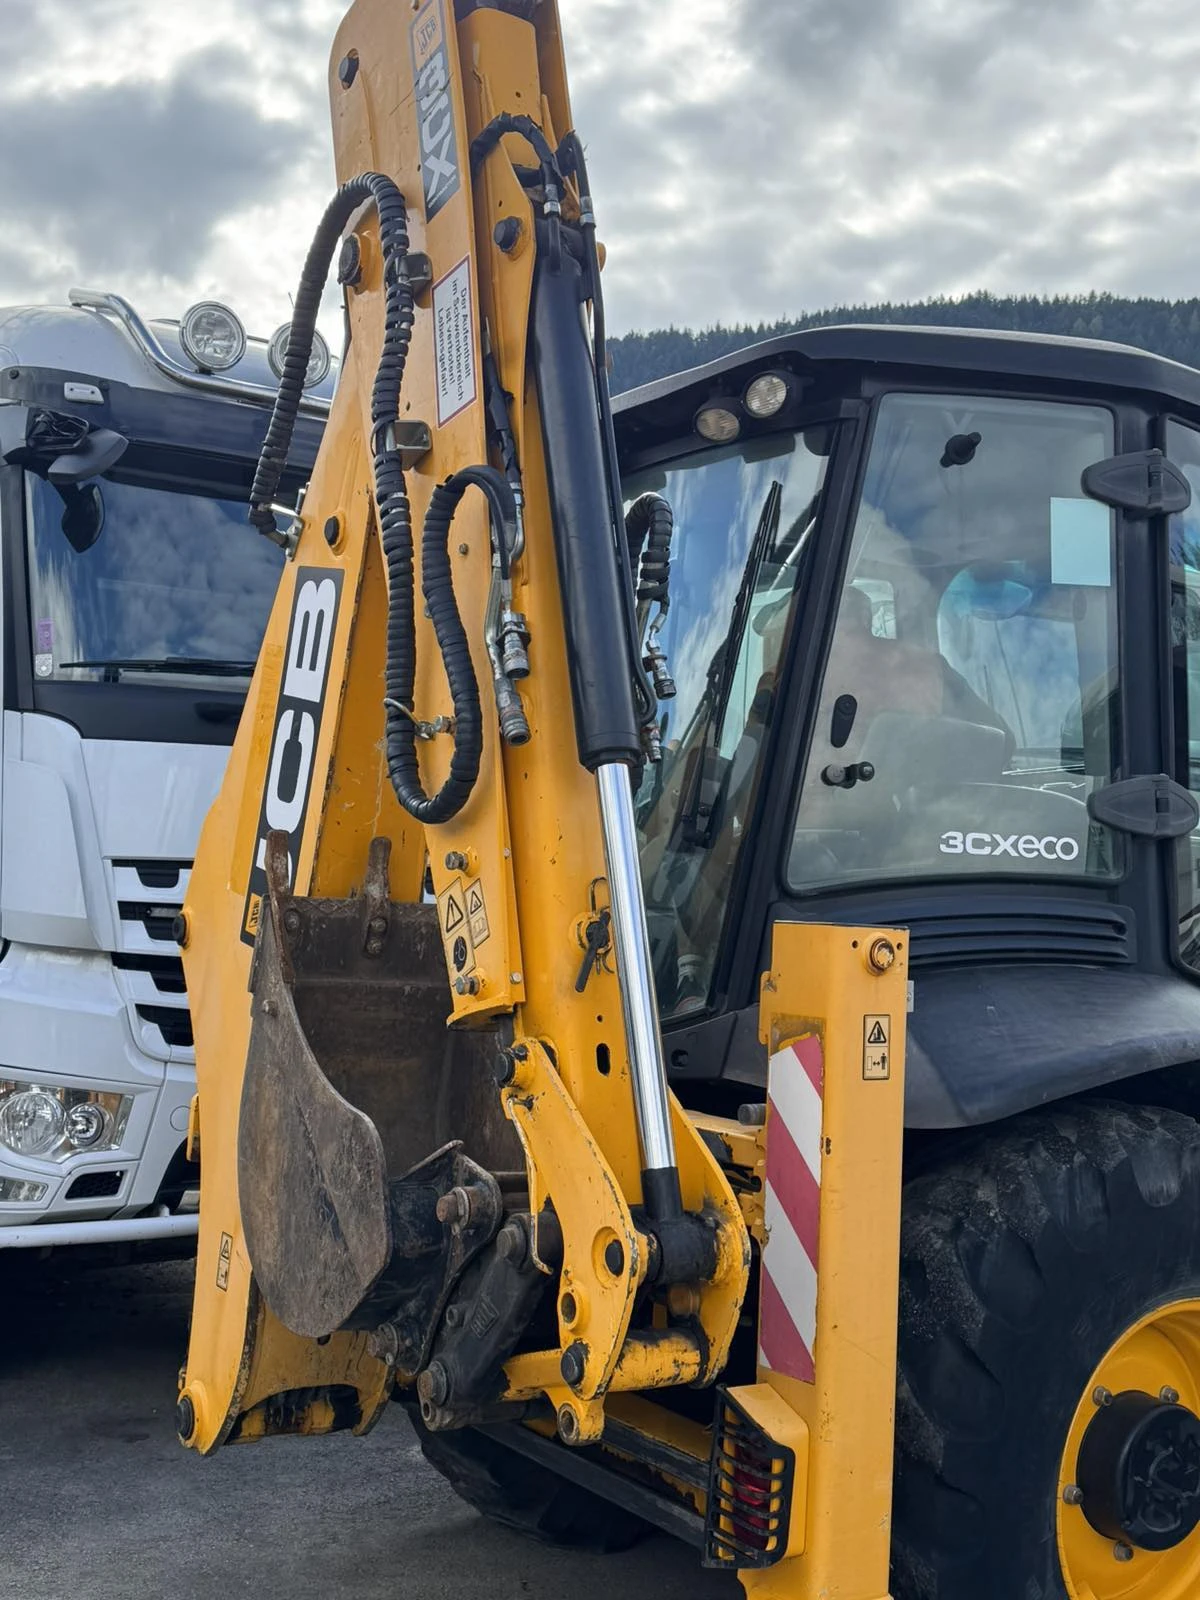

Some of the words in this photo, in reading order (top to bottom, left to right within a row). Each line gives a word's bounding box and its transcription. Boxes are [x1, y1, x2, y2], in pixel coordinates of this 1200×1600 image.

[419, 18, 437, 50] JCB
[418, 51, 457, 202] 3CX
[451, 279, 458, 296] im
[447, 326, 455, 385] verboten!
[453, 297, 465, 401] Schwenkbereich
[461, 313, 472, 379] Aufenthalt
